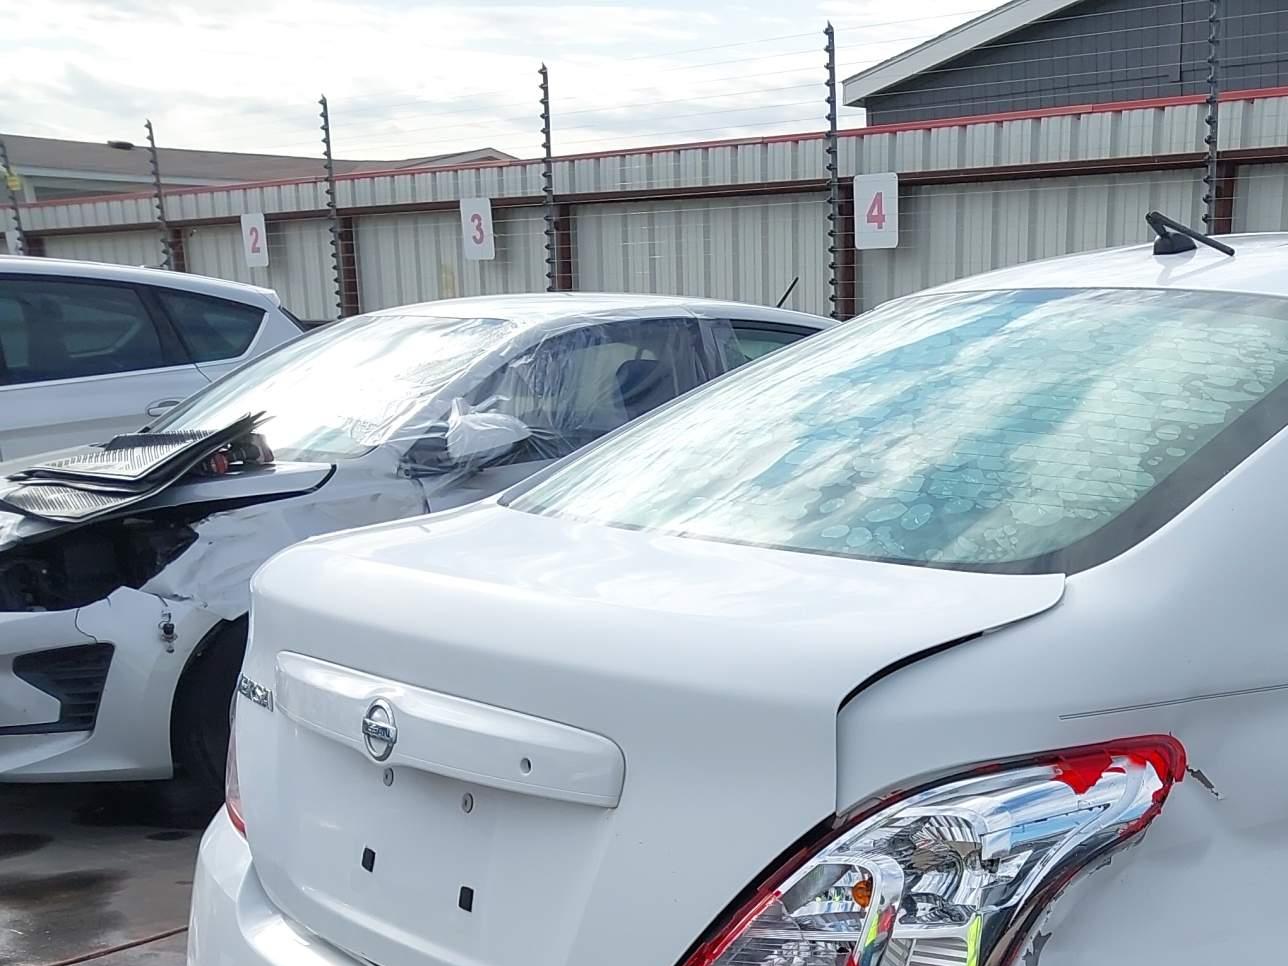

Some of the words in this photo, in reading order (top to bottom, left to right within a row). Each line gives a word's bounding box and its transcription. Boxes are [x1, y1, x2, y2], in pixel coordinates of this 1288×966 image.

[866, 191, 886, 230] 4
[249, 226, 261, 254] 2
[471, 213, 485, 245] 3
